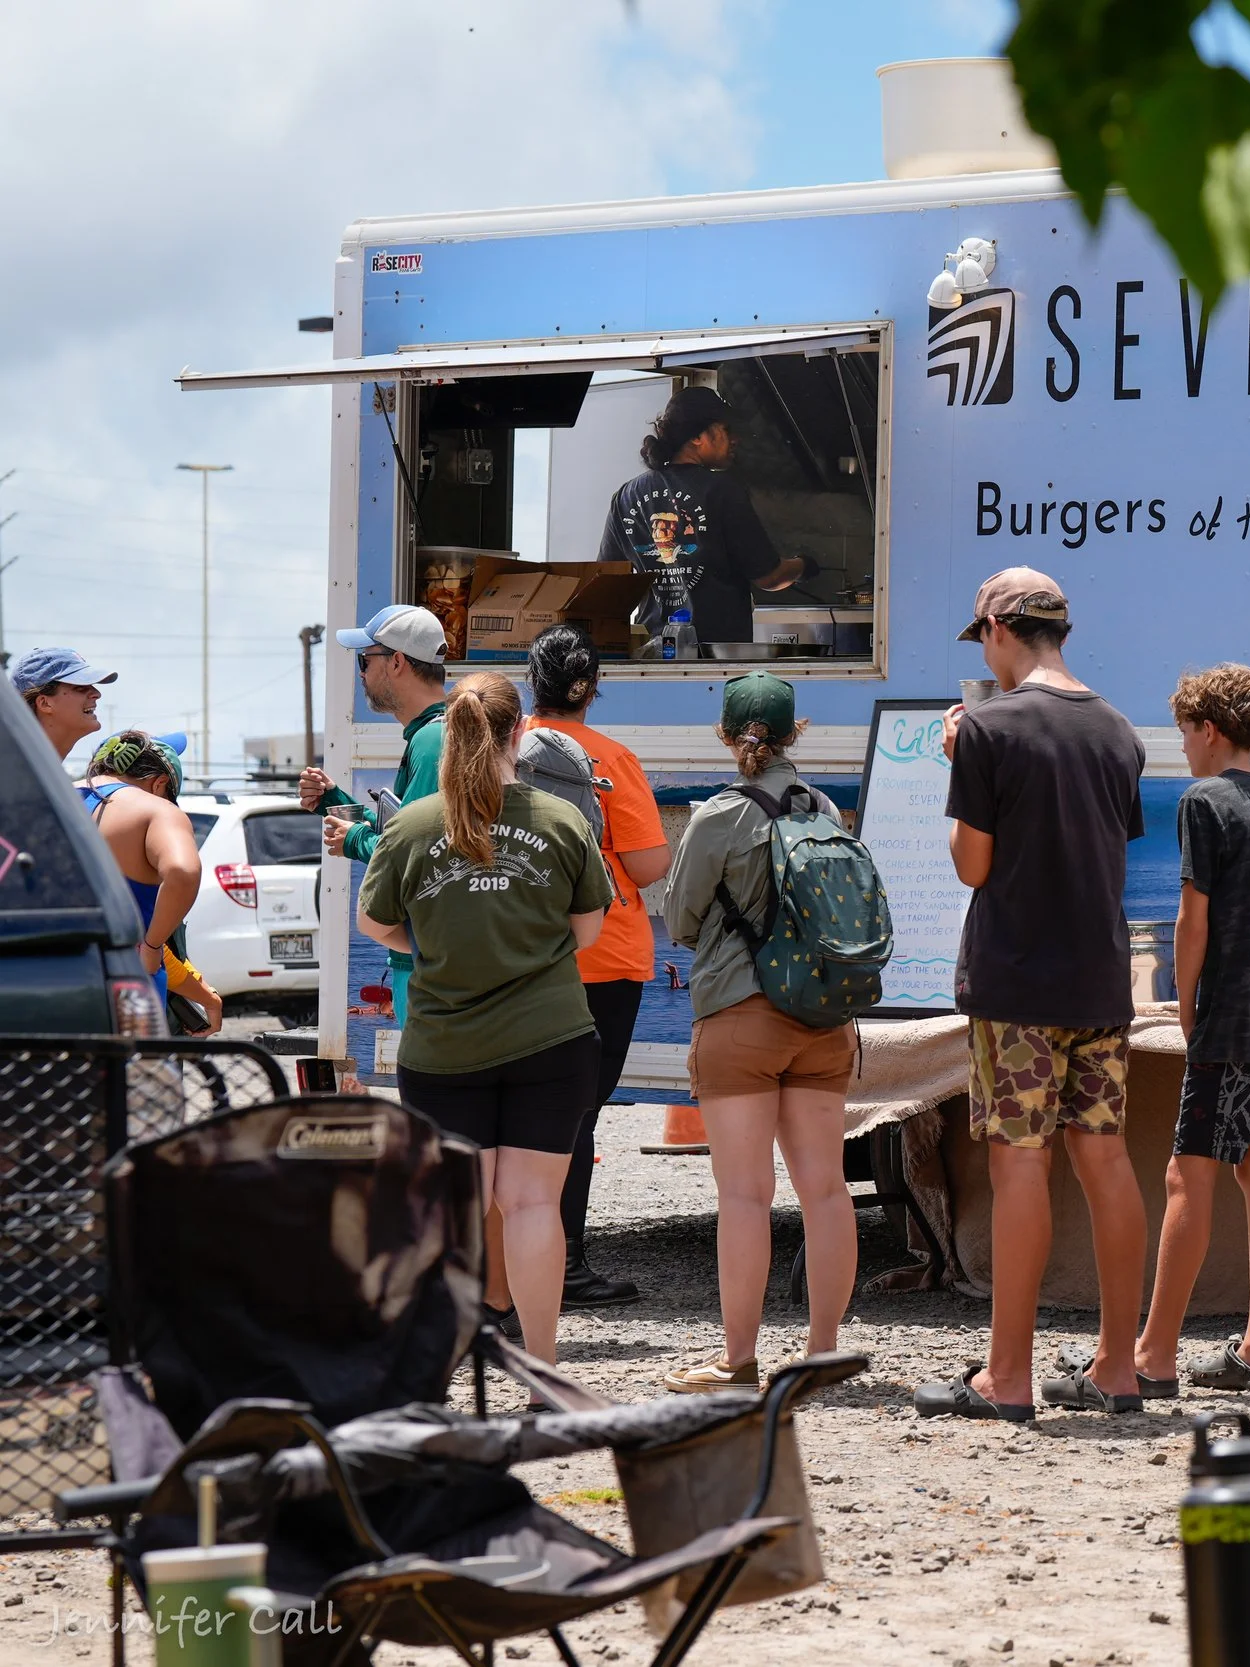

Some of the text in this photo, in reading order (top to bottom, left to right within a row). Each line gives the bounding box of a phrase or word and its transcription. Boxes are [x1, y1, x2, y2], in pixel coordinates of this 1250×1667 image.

[674, 490, 692, 503] OF
[693, 504, 708, 533] THE
[976, 481, 1167, 549] Burgers
[1189, 495, 1223, 541] of
[908, 794, 942, 806] SEVEN
[872, 813, 905, 825] LUNCH
[910, 814, 942, 826] STARTS
[513, 827, 549, 853] RUN
[869, 839, 911, 850] CHOOSE
[885, 860, 925, 870] CHICKEN
[468, 876, 510, 893] 2019
[888, 889, 973, 901] EEP THE COUNTRY
[888, 902, 921, 911] OUNTRY
[897, 928, 919, 937] WITH
[924, 927, 943, 937] SIDE
[891, 966, 911, 975] FIND
[914, 966, 930, 975] THE
[884, 980, 900, 989] FOR
[901, 980, 921, 989] YOUR
[923, 980, 942, 989] FOOD
[288, 1123, 370, 1149] Coleman
